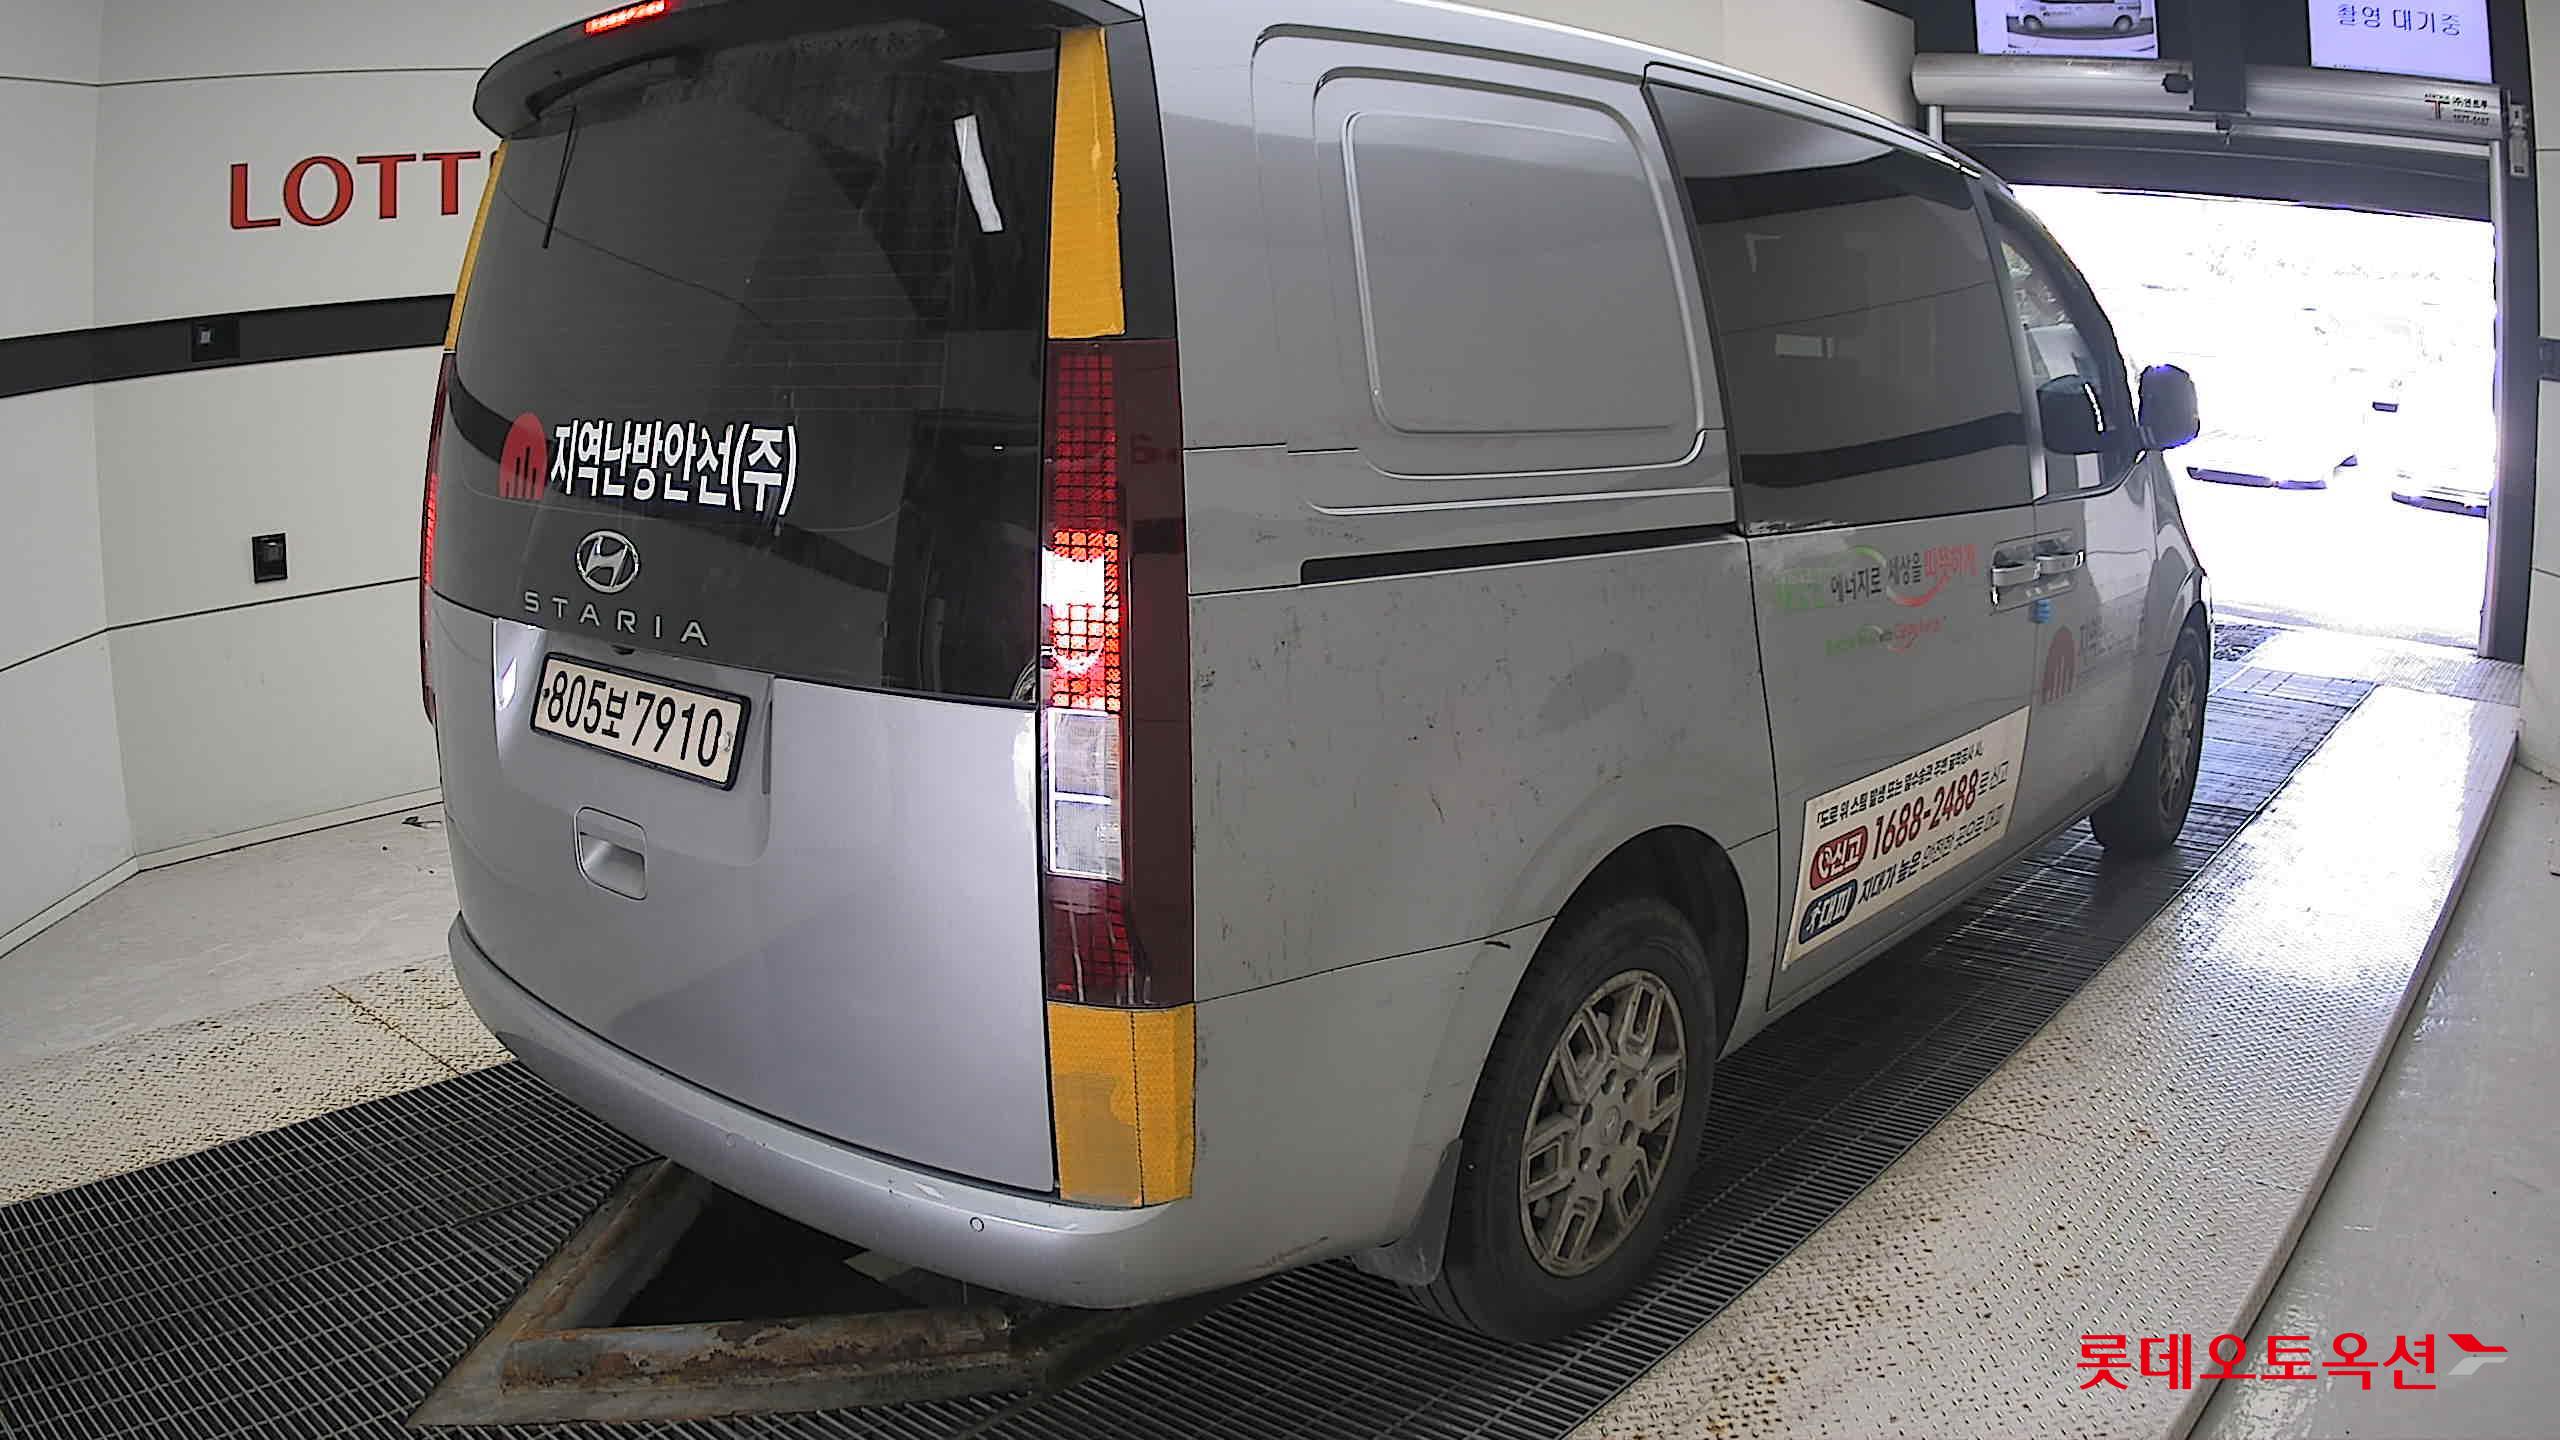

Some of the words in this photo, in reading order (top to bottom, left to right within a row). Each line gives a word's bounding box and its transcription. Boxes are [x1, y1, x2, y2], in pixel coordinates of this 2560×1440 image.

[2338, 5, 2381, 28] 촬영
[2393, 9, 2460, 36] 대기중
[230, 150, 498, 230] LOTT
[524, 591, 708, 647] STARIA
[547, 670, 723, 768] 805보7910
